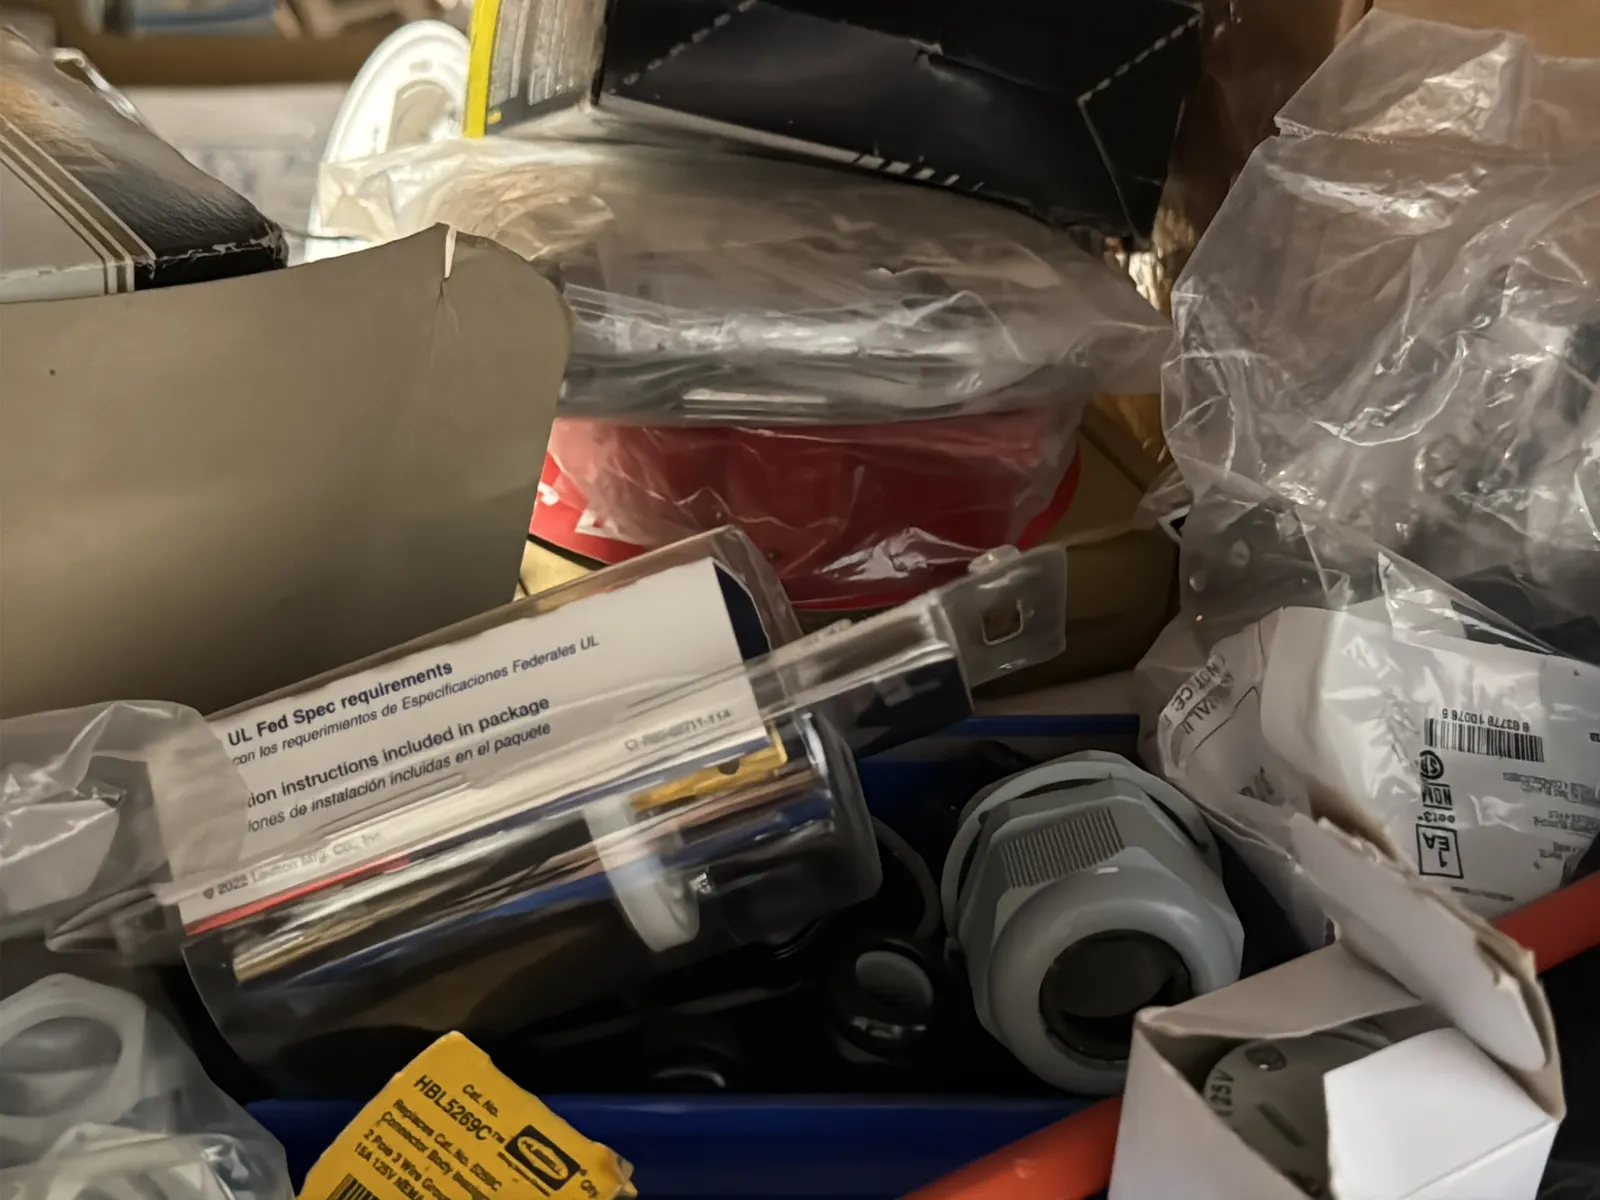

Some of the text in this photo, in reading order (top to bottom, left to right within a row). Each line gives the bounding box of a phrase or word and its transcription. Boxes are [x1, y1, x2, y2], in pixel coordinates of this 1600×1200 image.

[227, 662, 453, 746] UL Fed Spec requirements
[259, 741, 279, 759] los
[282, 708, 378, 751] requerimientos
[381, 702, 398, 717] de
[402, 666, 509, 710] Especificaciones
[512, 643, 576, 673] Federales
[580, 634, 599, 651] UL
[281, 753, 379, 797] instructions
[382, 726, 454, 763] included
[457, 721, 475, 737] in
[478, 698, 550, 733] package
[289, 803, 308, 819] de
[311, 775, 386, 812] instalación
[390, 755, 451, 786] incluidas
[455, 749, 473, 763] en
[477, 741, 490, 757] el
[494, 723, 551, 755] paquete
[1422, 832, 1450, 851] EA
[1438, 850, 1448, 868] 1
[462, 1084, 498, 1118] Cat. No.
[363, 1128, 374, 1140] 2
[391, 1152, 402, 1164] 3
[434, 1132, 454, 1155] Cat.
